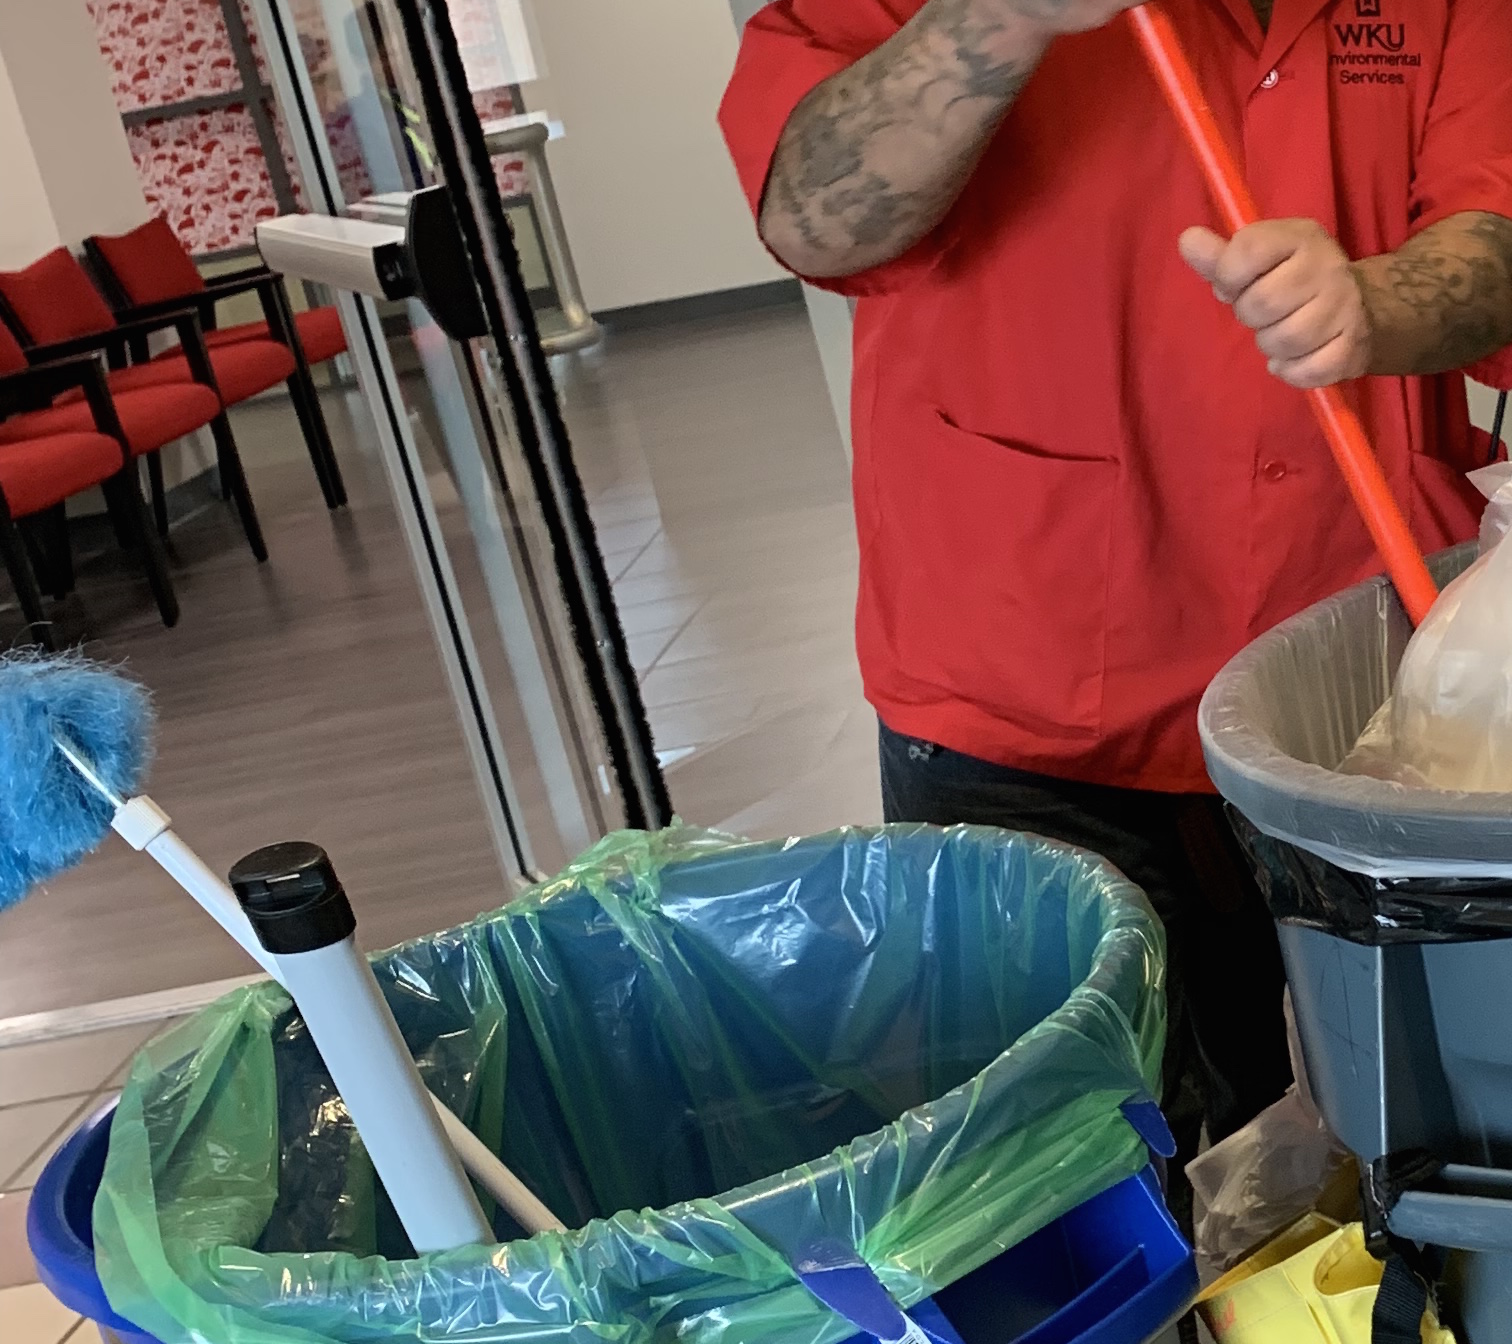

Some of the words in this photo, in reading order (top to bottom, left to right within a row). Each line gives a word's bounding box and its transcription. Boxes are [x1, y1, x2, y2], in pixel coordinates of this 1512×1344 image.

[1334, 23, 1405, 52] WKU
[1329, 51, 1421, 67] nvironmental
[1340, 70, 1405, 85] Services
